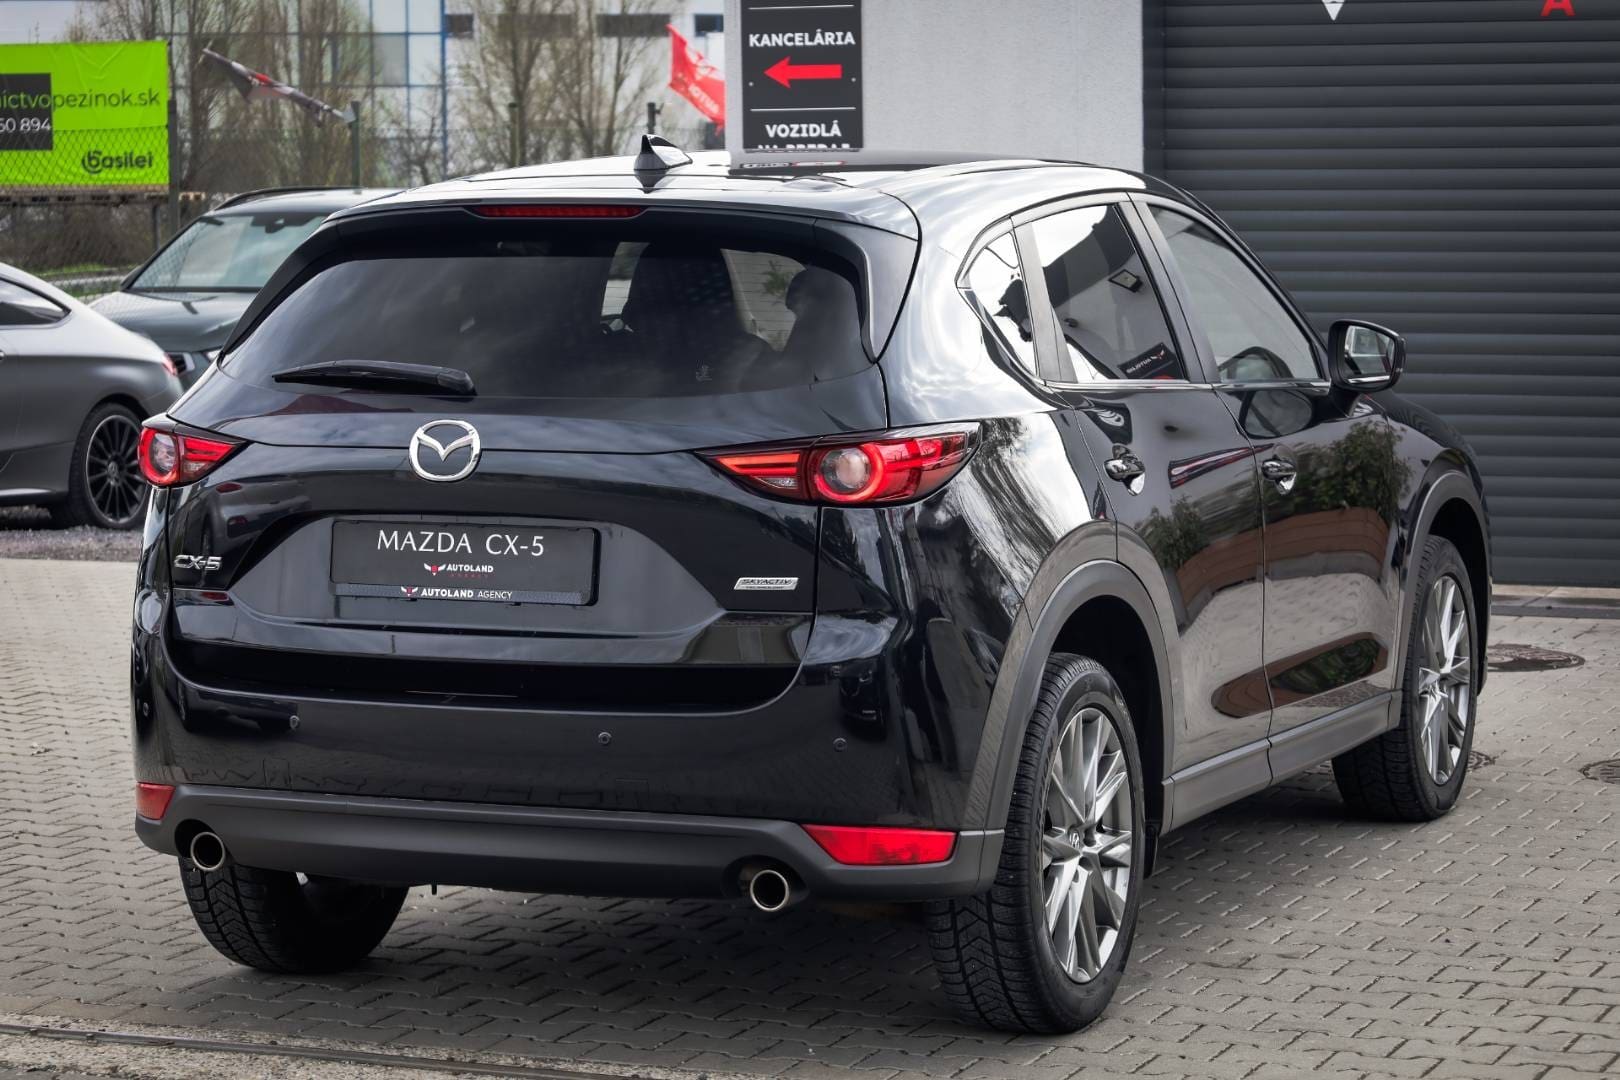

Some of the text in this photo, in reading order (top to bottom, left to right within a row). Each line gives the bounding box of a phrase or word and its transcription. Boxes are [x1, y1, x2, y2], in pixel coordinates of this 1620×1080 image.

[749, 29, 856, 47] KANCELÁRIA
[0, 88, 160, 112] ictvopezinok.sk
[20, 117, 51, 133] 894
[765, 120, 842, 138] VOZIDLÁ
[377, 529, 545, 556] MAZDA CX-5
[174, 554, 222, 571] CX-5
[446, 563, 494, 573] AUTOLAND
[421, 588, 513, 599] AUTOLAND AGENCY
